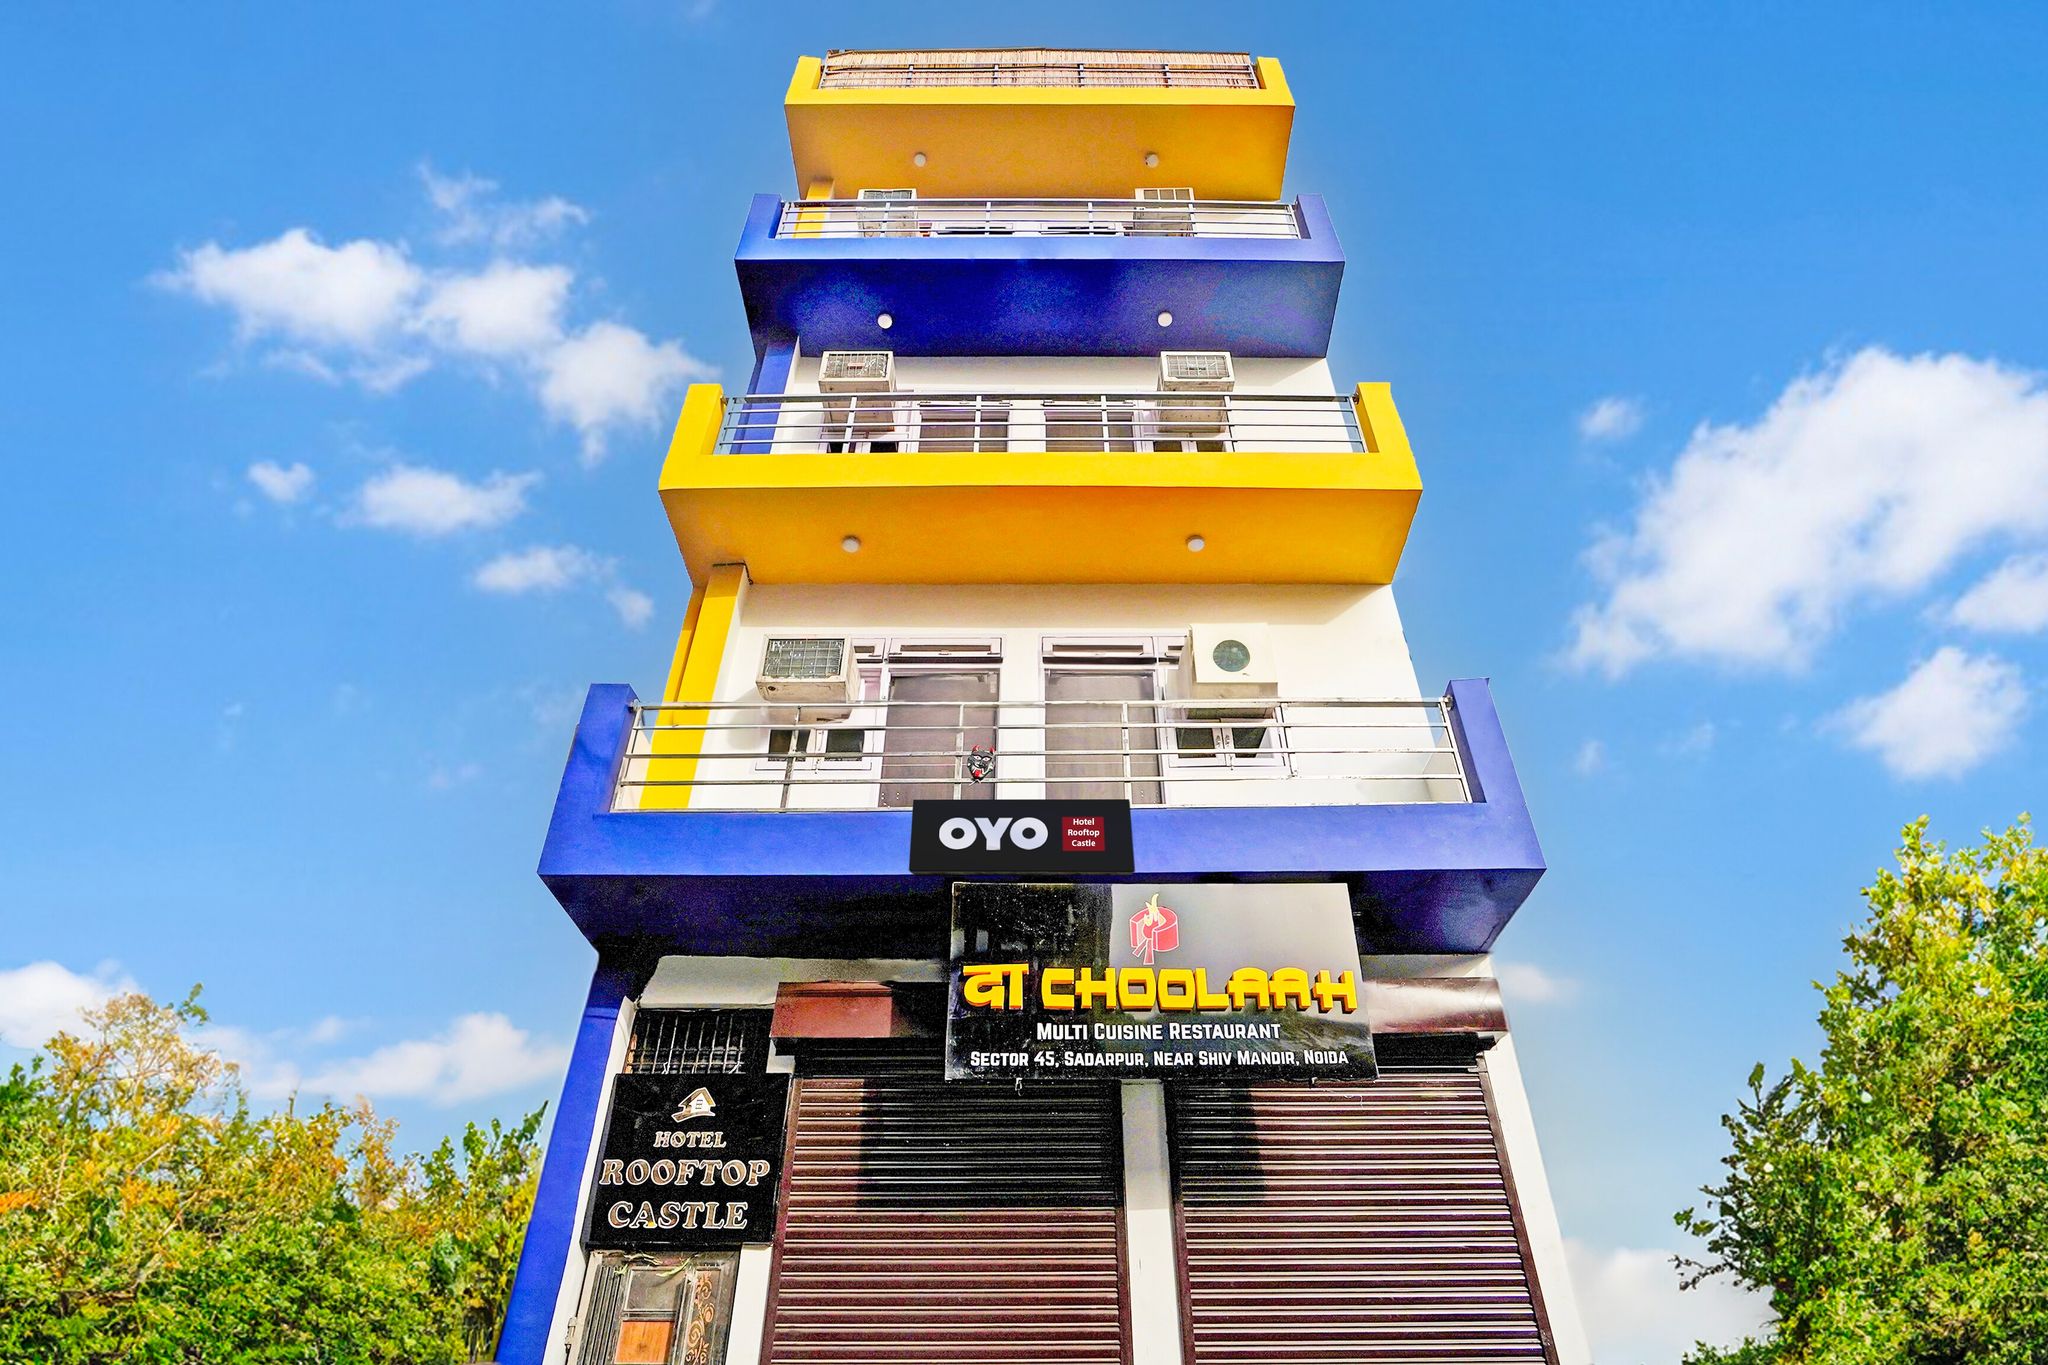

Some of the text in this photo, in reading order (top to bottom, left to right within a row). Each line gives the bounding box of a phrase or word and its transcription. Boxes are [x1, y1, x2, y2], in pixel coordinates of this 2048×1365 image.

[939, 817, 1048, 850] OYO
[1068, 829, 1099, 837] Rooftop
[962, 963, 1358, 1013] दा CHOOLAAH
[1037, 1022, 1281, 1040] MULTI CUISINE RESTAURANT
[970, 1050, 1348, 1068] SECTOR 45, SADARPUR, NEAR SHIV MANDIR, NOIDA
[654, 1131, 726, 1148] HOTEL
[599, 1159, 770, 1186] ROOFTOP
[608, 1201, 748, 1229] CASTLE
